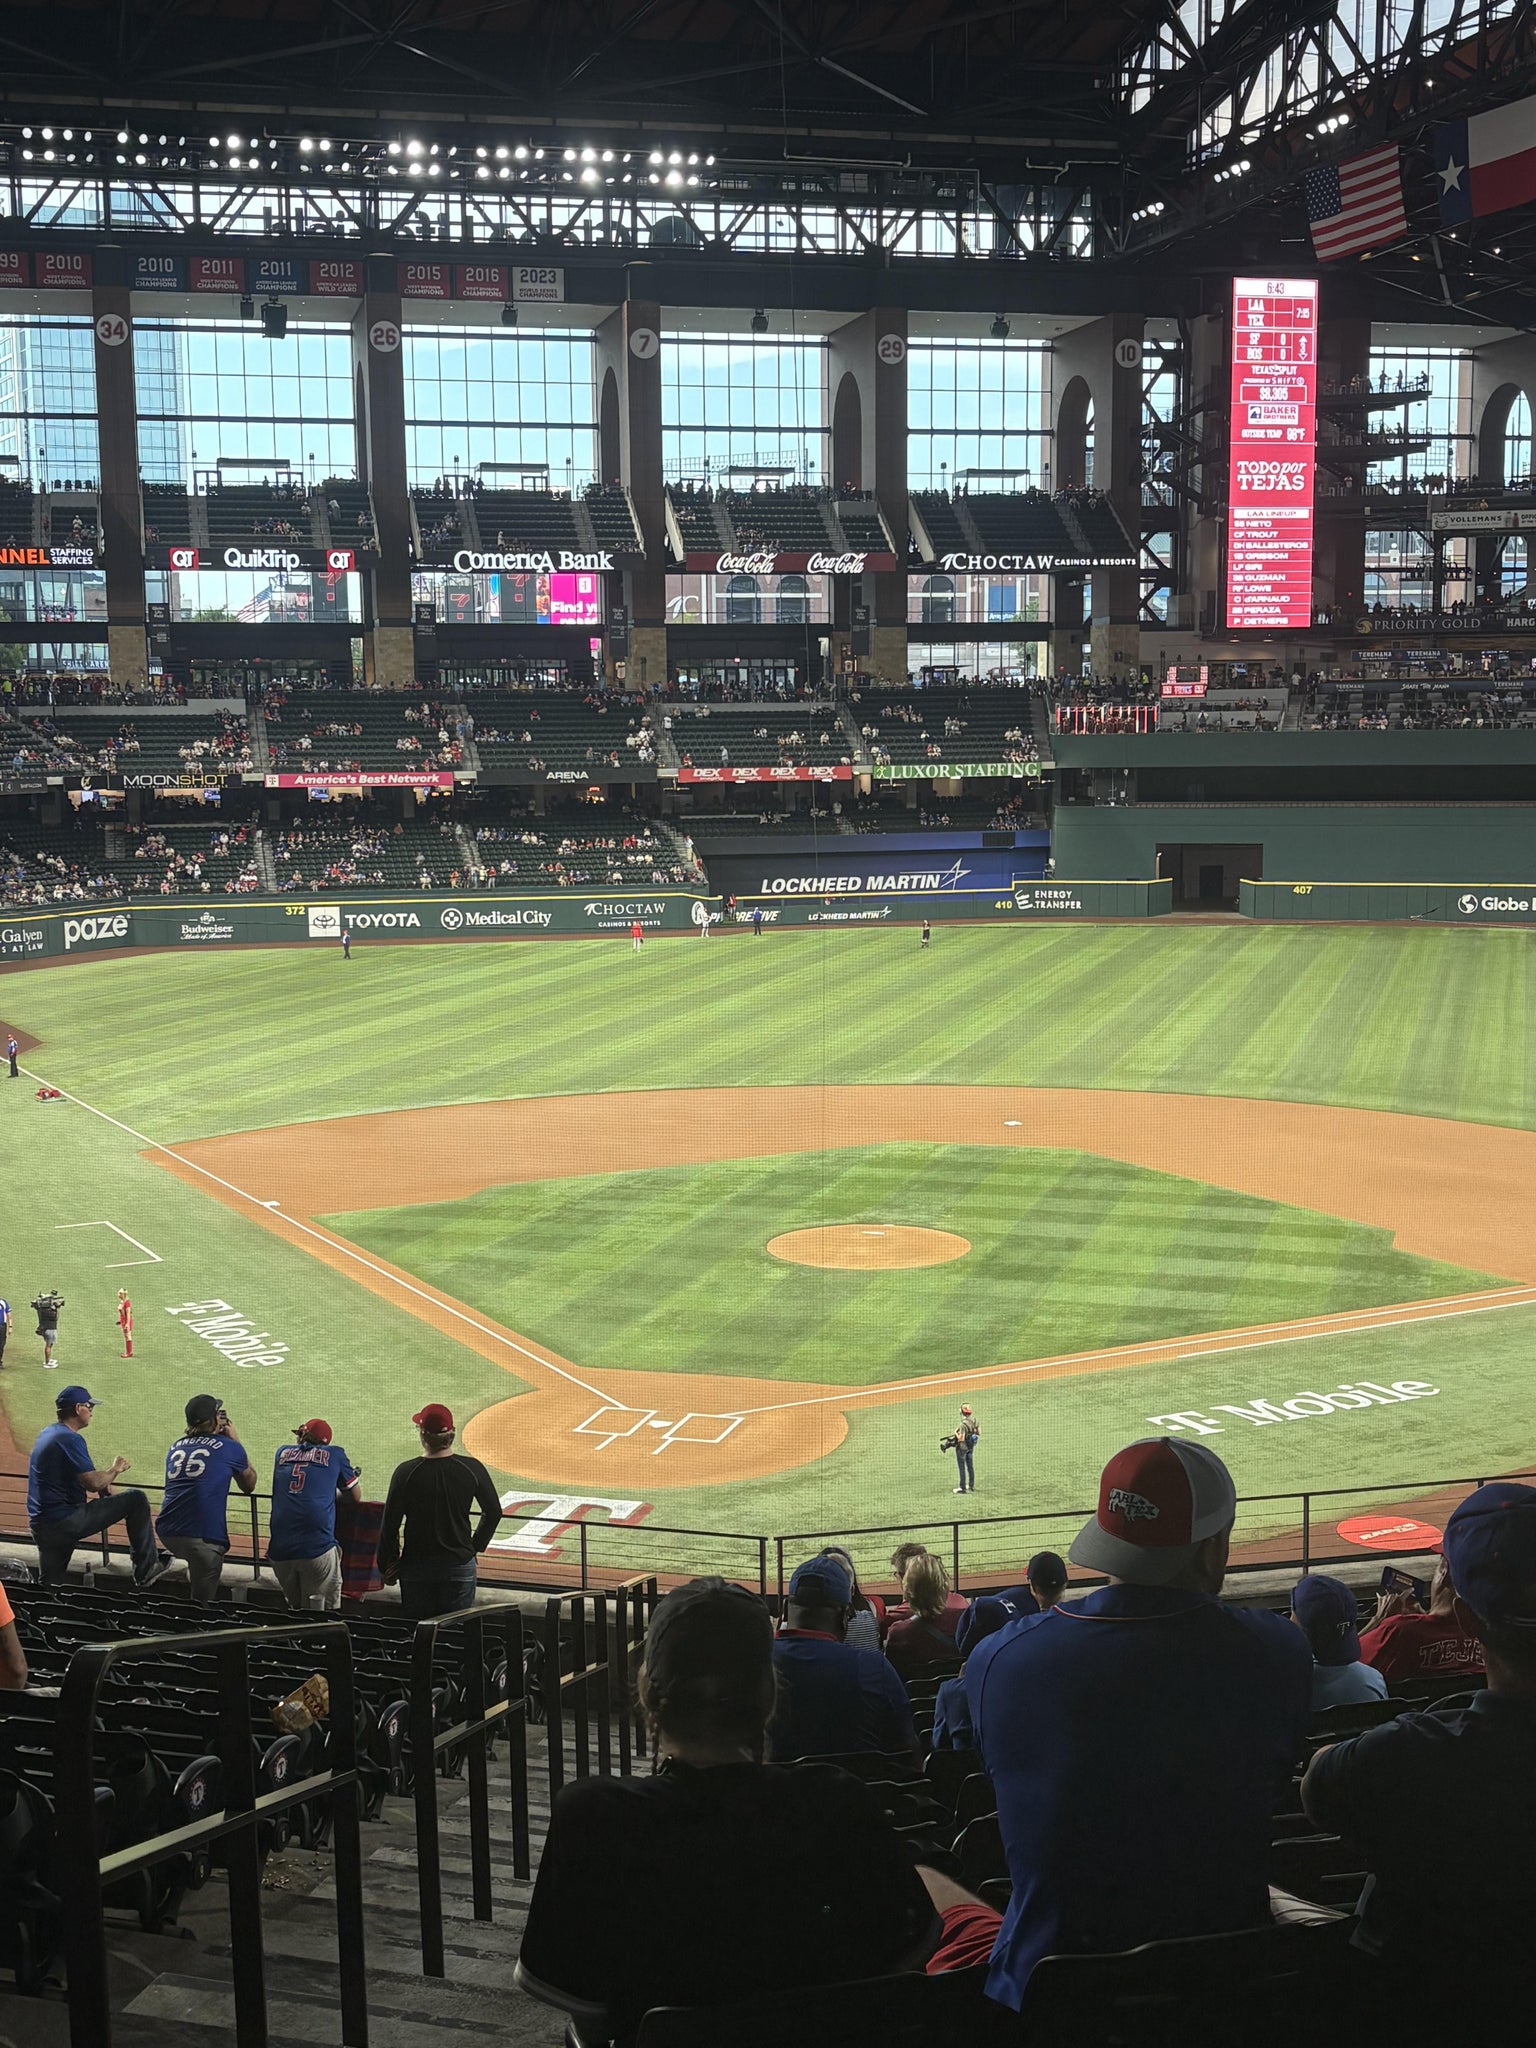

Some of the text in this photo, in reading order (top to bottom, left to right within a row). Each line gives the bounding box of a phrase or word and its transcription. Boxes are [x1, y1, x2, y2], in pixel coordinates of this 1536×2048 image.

[46, 255, 82, 270] 2010
[138, 257, 174, 273] 2010
[202, 259, 233, 275] 2011
[260, 261, 292, 276] 2011
[320, 263, 354, 278] 2012
[407, 265, 441, 280] 2015
[466, 267, 499, 282] 2016
[520, 269, 557, 284] 2023
[1267, 282, 1285, 295] 6:43
[1248, 299, 1264, 311] LAA
[1248, 314, 1265, 327] TEX
[101, 320, 126, 340] 34
[373, 328, 396, 346] 26
[638, 335, 650, 352] 7
[1249, 333, 1261, 346] SF
[1279, 333, 1287, 346] 0
[880, 340, 901, 358] 29
[1121, 345, 1136, 362] 10
[1247, 348, 1263, 361] BOS
[1279, 348, 1287, 361] 0
[1279, 366, 1298, 376] SPLIT
[1263, 406, 1297, 414] BAKER
[1237, 461, 1307, 481] TODO por
[1237, 475, 1305, 491] TEJAS
[1450, 515, 1502, 523] VOLLEMANS
[50, 548, 94, 557] STAFFING
[172, 550, 195, 570] QT
[224, 547, 300, 570] QuikTrip
[52, 556, 93, 565] SERVICES
[328, 551, 351, 570] QT
[559, 550, 615, 571] Bank
[716, 551, 778, 574] Coca-Cola
[807, 551, 868, 574] Coca-Cola
[951, 552, 1054, 570] CHOCTAW
[1054, 558, 1091, 566] CASINOS
[1100, 558, 1137, 566] RESORTS
[551, 600, 583, 614] Find
[1375, 618, 1481, 631] PRIORITY GOLD
[546, 771, 589, 780] ARENA
[693, 769, 721, 777] DEX
[732, 768, 760, 776] DEX
[770, 767, 798, 775] DEX
[808, 767, 836, 775] DEX
[890, 762, 1038, 779] LUXOR STAFFING
[123, 774, 228, 786] MOONSHOT
[294, 775, 357, 785] America's
[359, 774, 386, 785] Best
[388, 774, 440, 784] Network
[761, 874, 941, 894] LOCKHEED MARTIN
[1292, 885, 1313, 896] 407
[1034, 890, 1073, 899] ENERGY
[285, 906, 305, 916] 372
[591, 902, 666, 916] CHOCTAW
[995, 901, 1013, 909] 410
[1034, 900, 1082, 910] TRANSFER
[1481, 896, 1529, 911] Globe
[345, 912, 421, 929] TOYOTA
[465, 910, 552, 927] Medical City
[849, 911, 880, 920] MARTIN
[181, 924, 234, 934] Budweiser
[2, 929, 43, 945] Galyen
[12, 945, 24, 953] AT
[28, 943, 44, 952] LAW
[167, 1448, 211, 1480] 36
[289, 1462, 309, 1492] 5
[1418, 1637, 1486, 1667] TEJA
